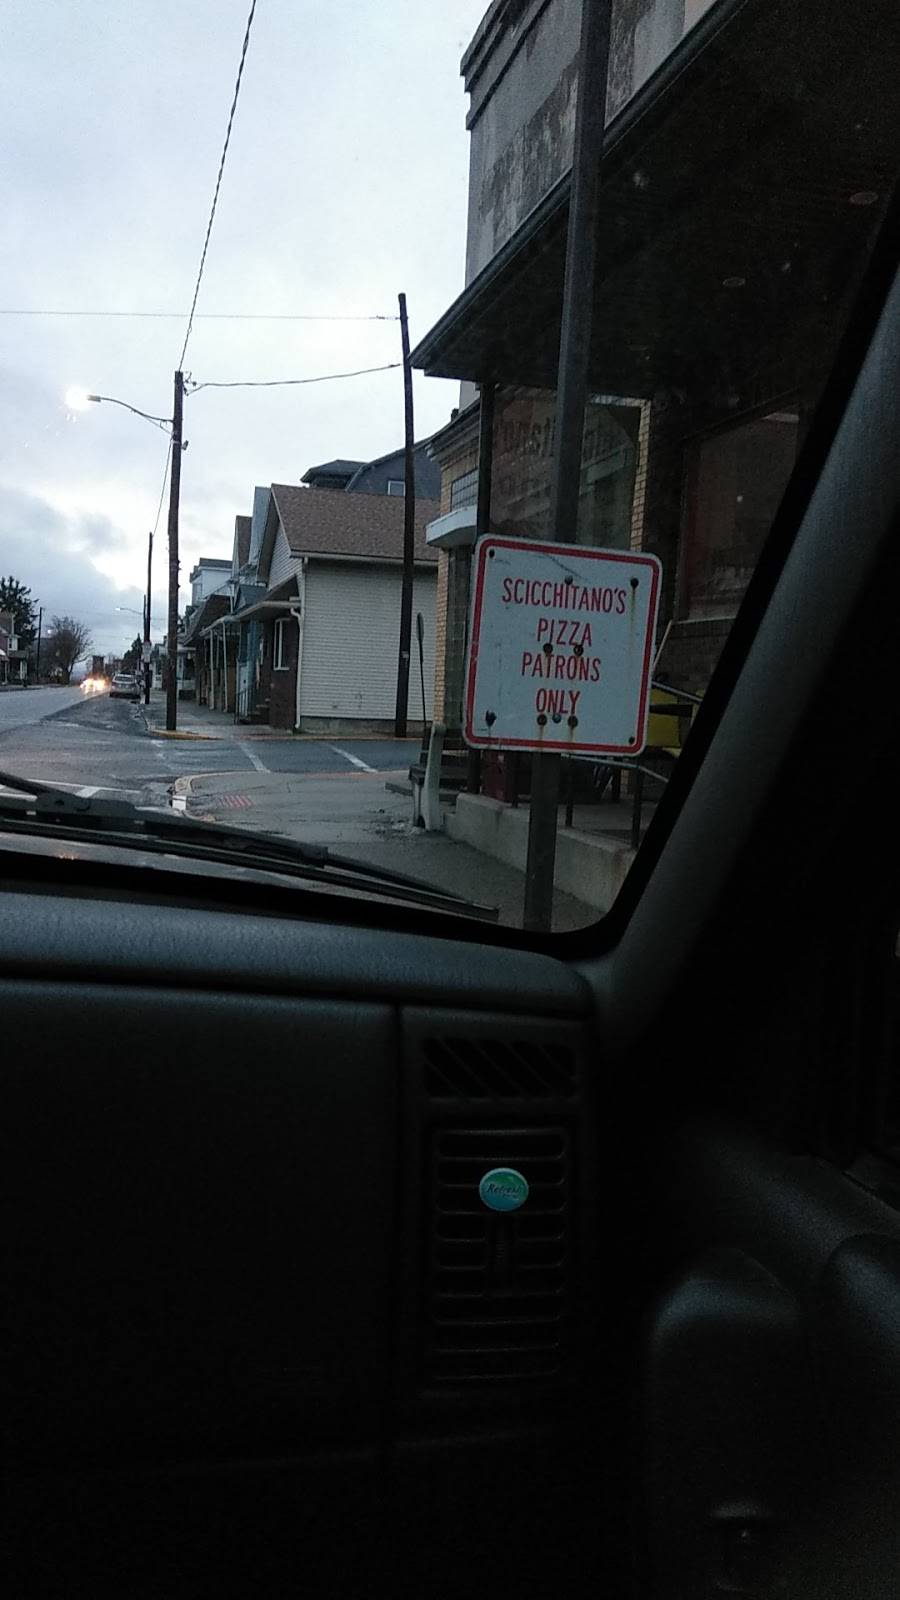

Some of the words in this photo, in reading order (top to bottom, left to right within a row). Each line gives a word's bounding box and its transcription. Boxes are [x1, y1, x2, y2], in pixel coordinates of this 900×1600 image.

[502, 578, 627, 614] SCICCHITANO'S
[536, 618, 592, 647] PIZZA
[521, 652, 602, 682] PATRONS
[536, 688, 580, 714] ONLY
